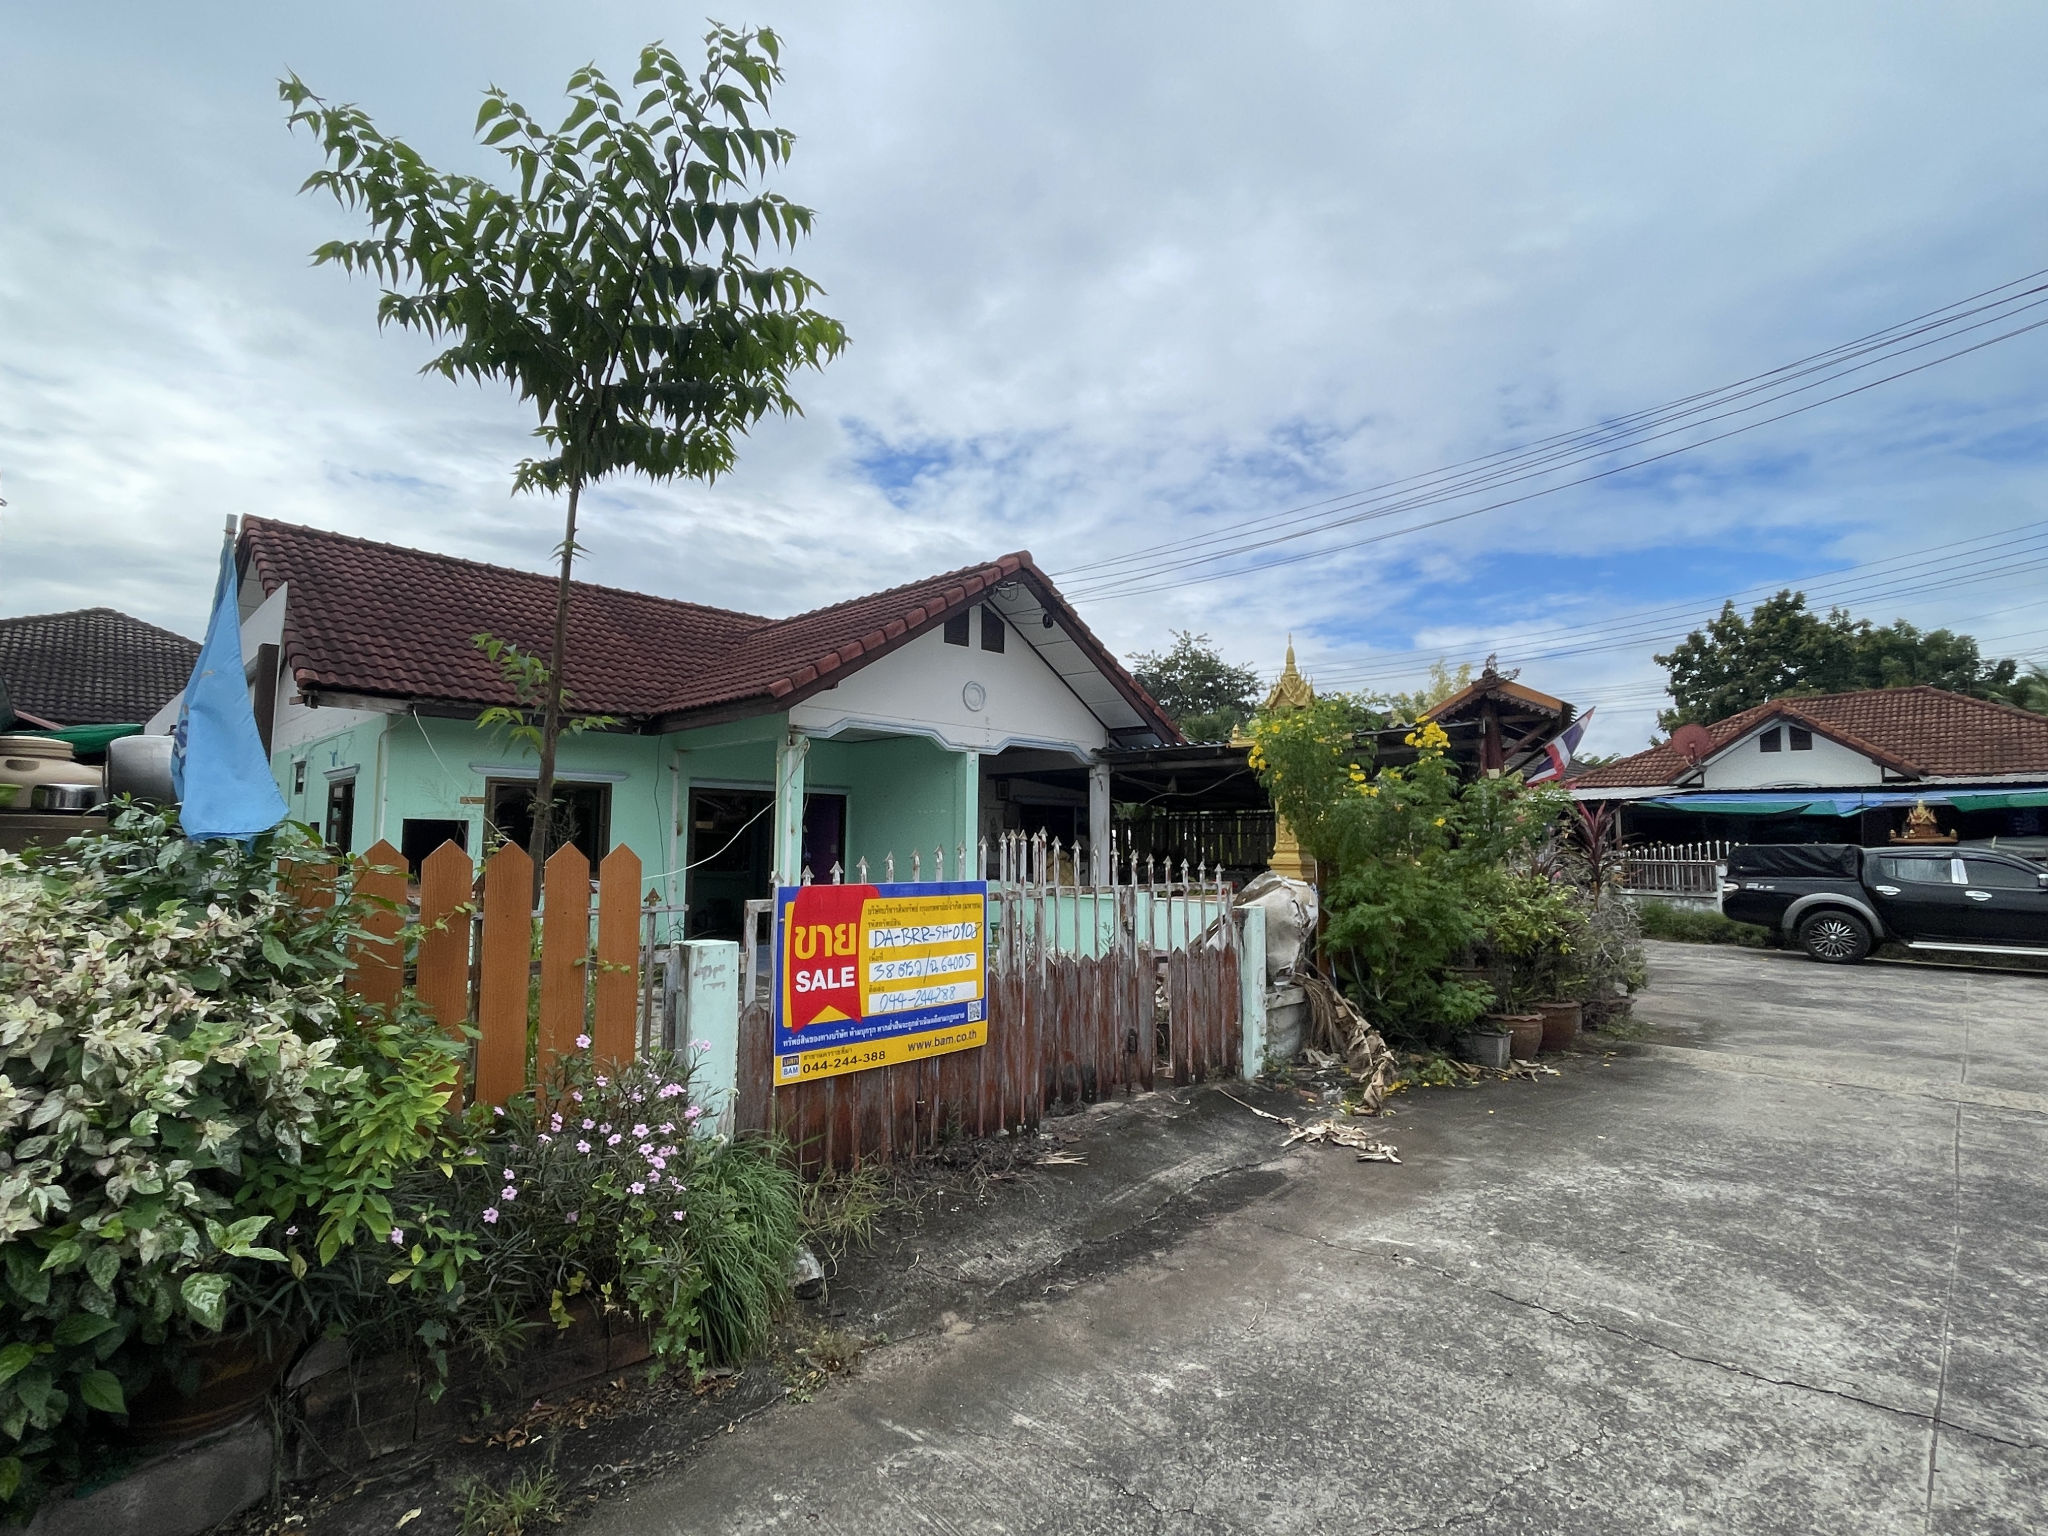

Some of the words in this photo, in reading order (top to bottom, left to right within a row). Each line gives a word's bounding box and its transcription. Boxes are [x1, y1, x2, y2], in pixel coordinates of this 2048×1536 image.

[795, 923, 857, 960] ขาย
[795, 966, 856, 993] SALE
[873, 964, 895, 982] 38
[907, 1029, 977, 1051] www.bam.co.th
[783, 1066, 799, 1076] BAM
[803, 1050, 885, 1074] 044-244-388
